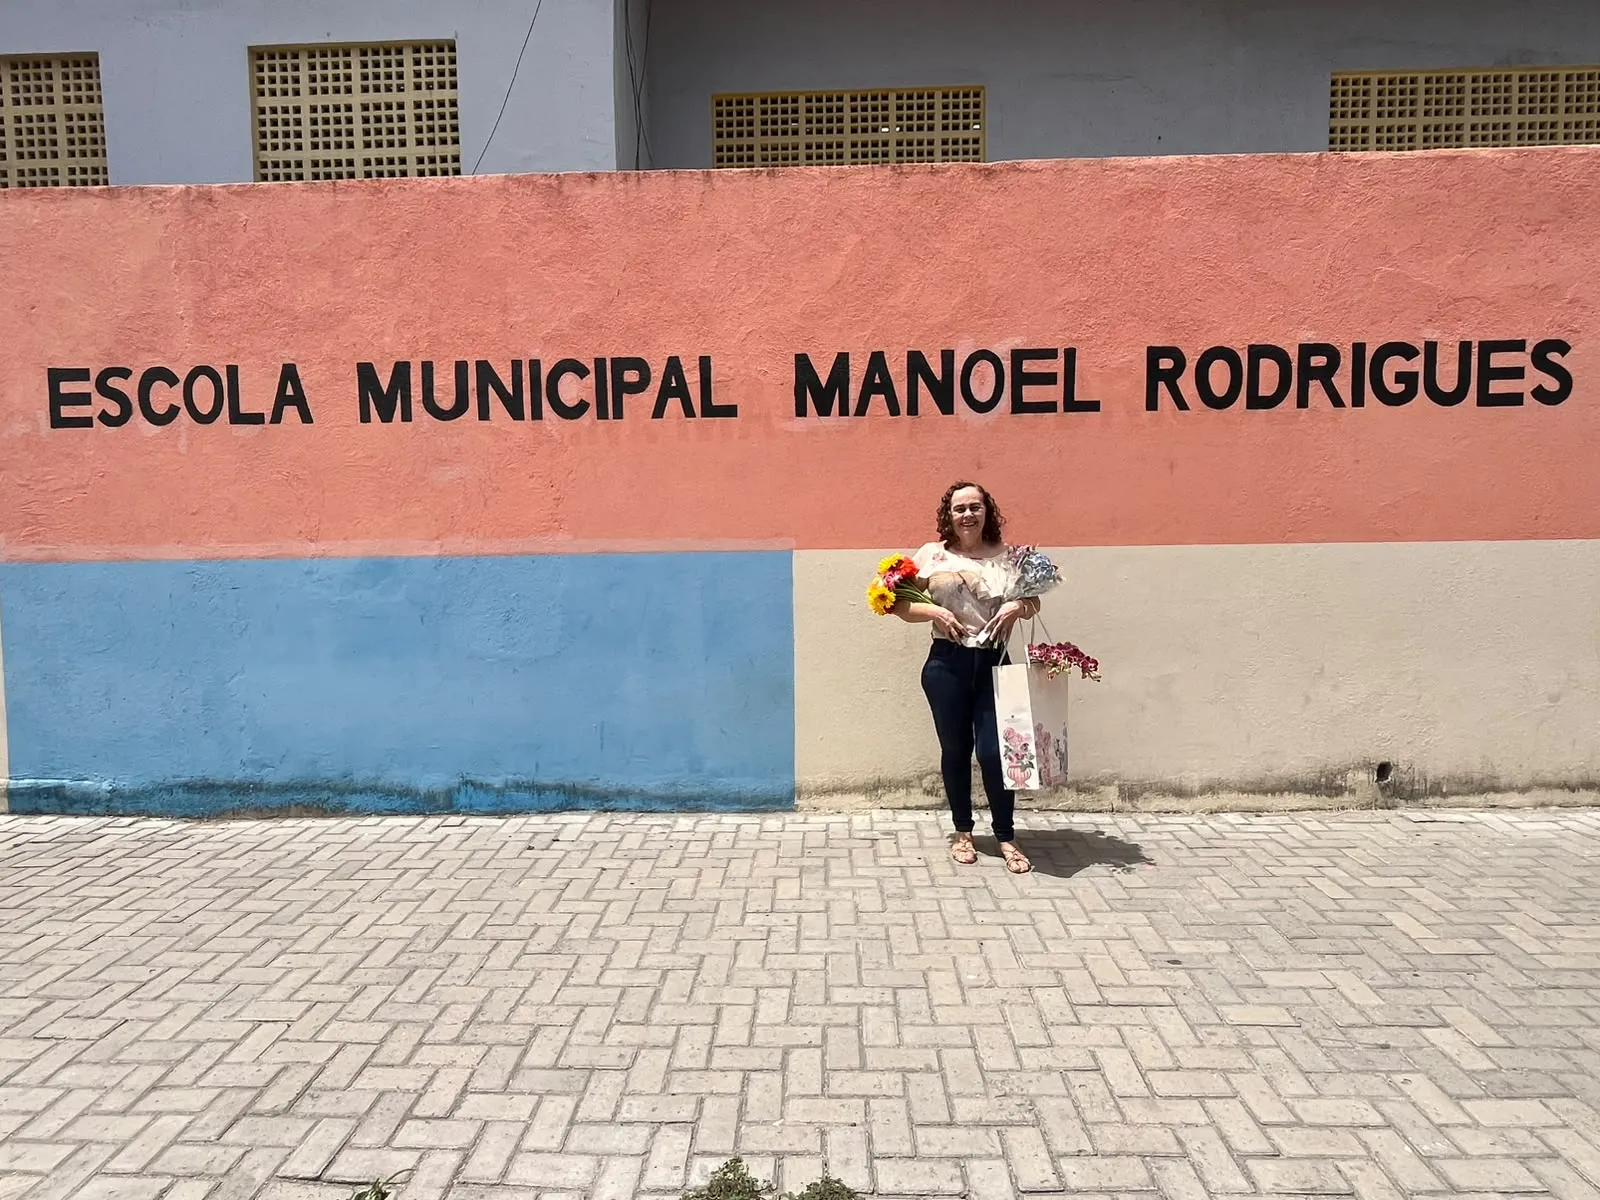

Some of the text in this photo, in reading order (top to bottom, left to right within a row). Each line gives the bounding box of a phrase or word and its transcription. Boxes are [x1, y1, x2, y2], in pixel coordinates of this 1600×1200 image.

[47, 338, 1574, 430] ESCOLA MUNICIPAL MANOEL RODRIGUES
